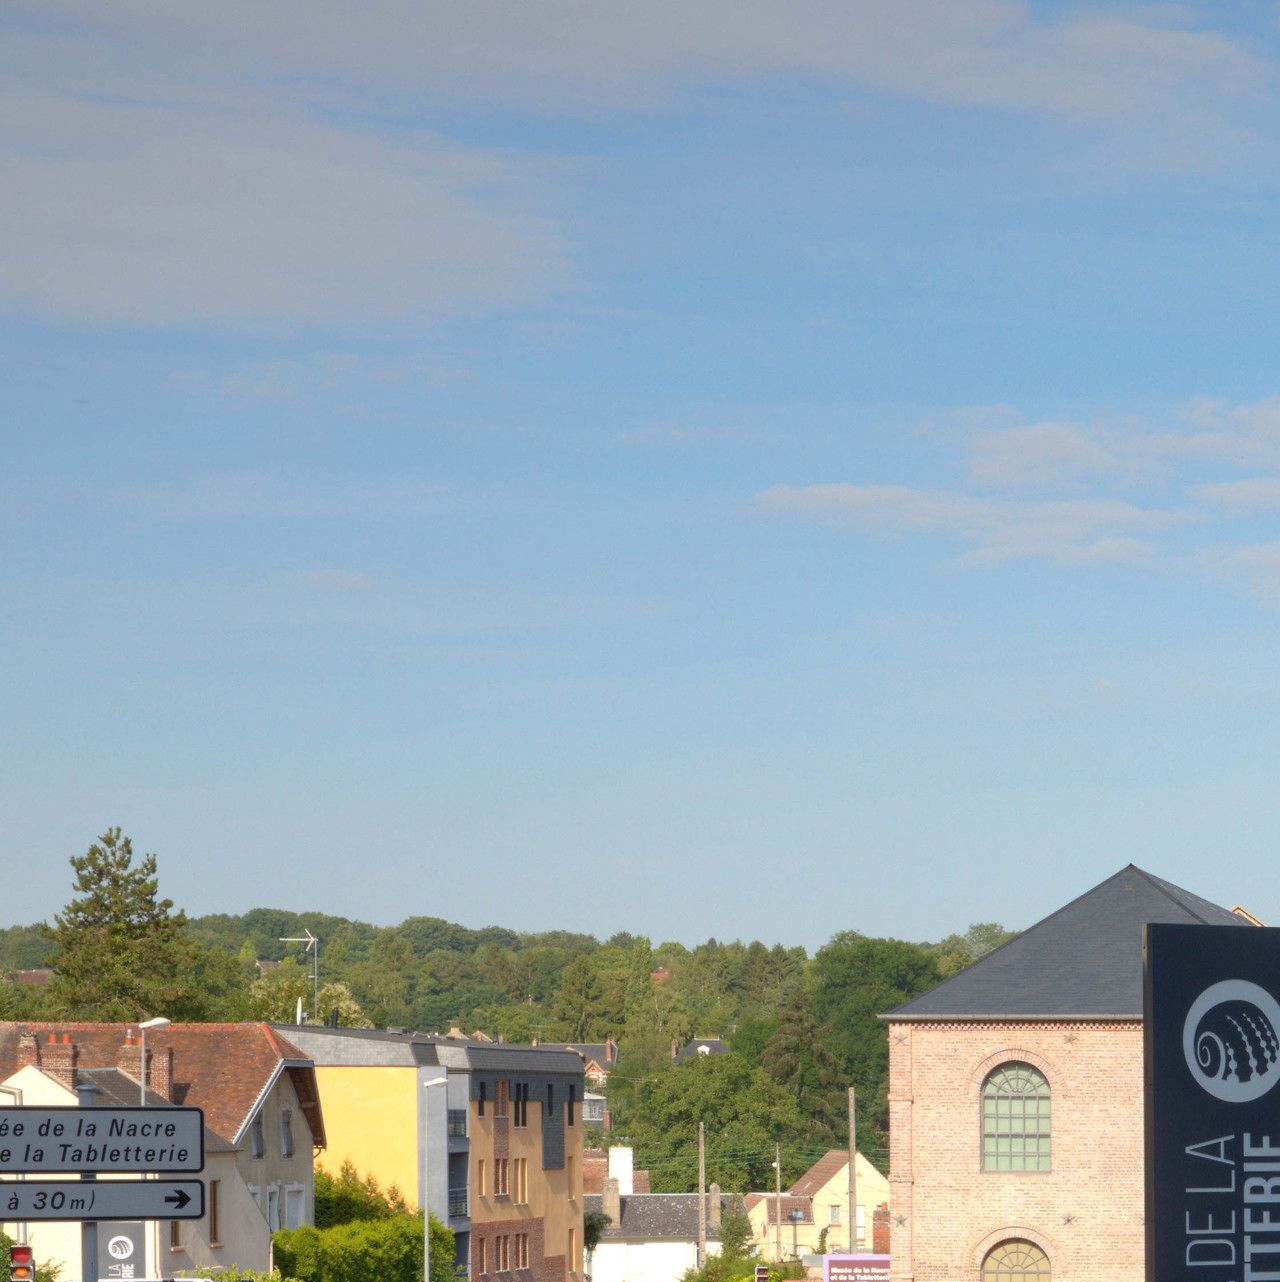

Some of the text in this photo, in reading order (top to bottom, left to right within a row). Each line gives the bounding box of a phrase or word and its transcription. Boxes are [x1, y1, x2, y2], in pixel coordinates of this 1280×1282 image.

[38, 1118, 65, 1137] de
[77, 1118, 97, 1137] la
[109, 1118, 176, 1137] Nacre
[23, 1144, 45, 1162] la
[59, 1144, 189, 1162] Tabletterie
[1185, 1134, 1236, 1193] LA
[8, 1191, 20, 1211] à
[1185, 1210, 1236, 1267] DE
[108, 1263, 122, 1277] LA
